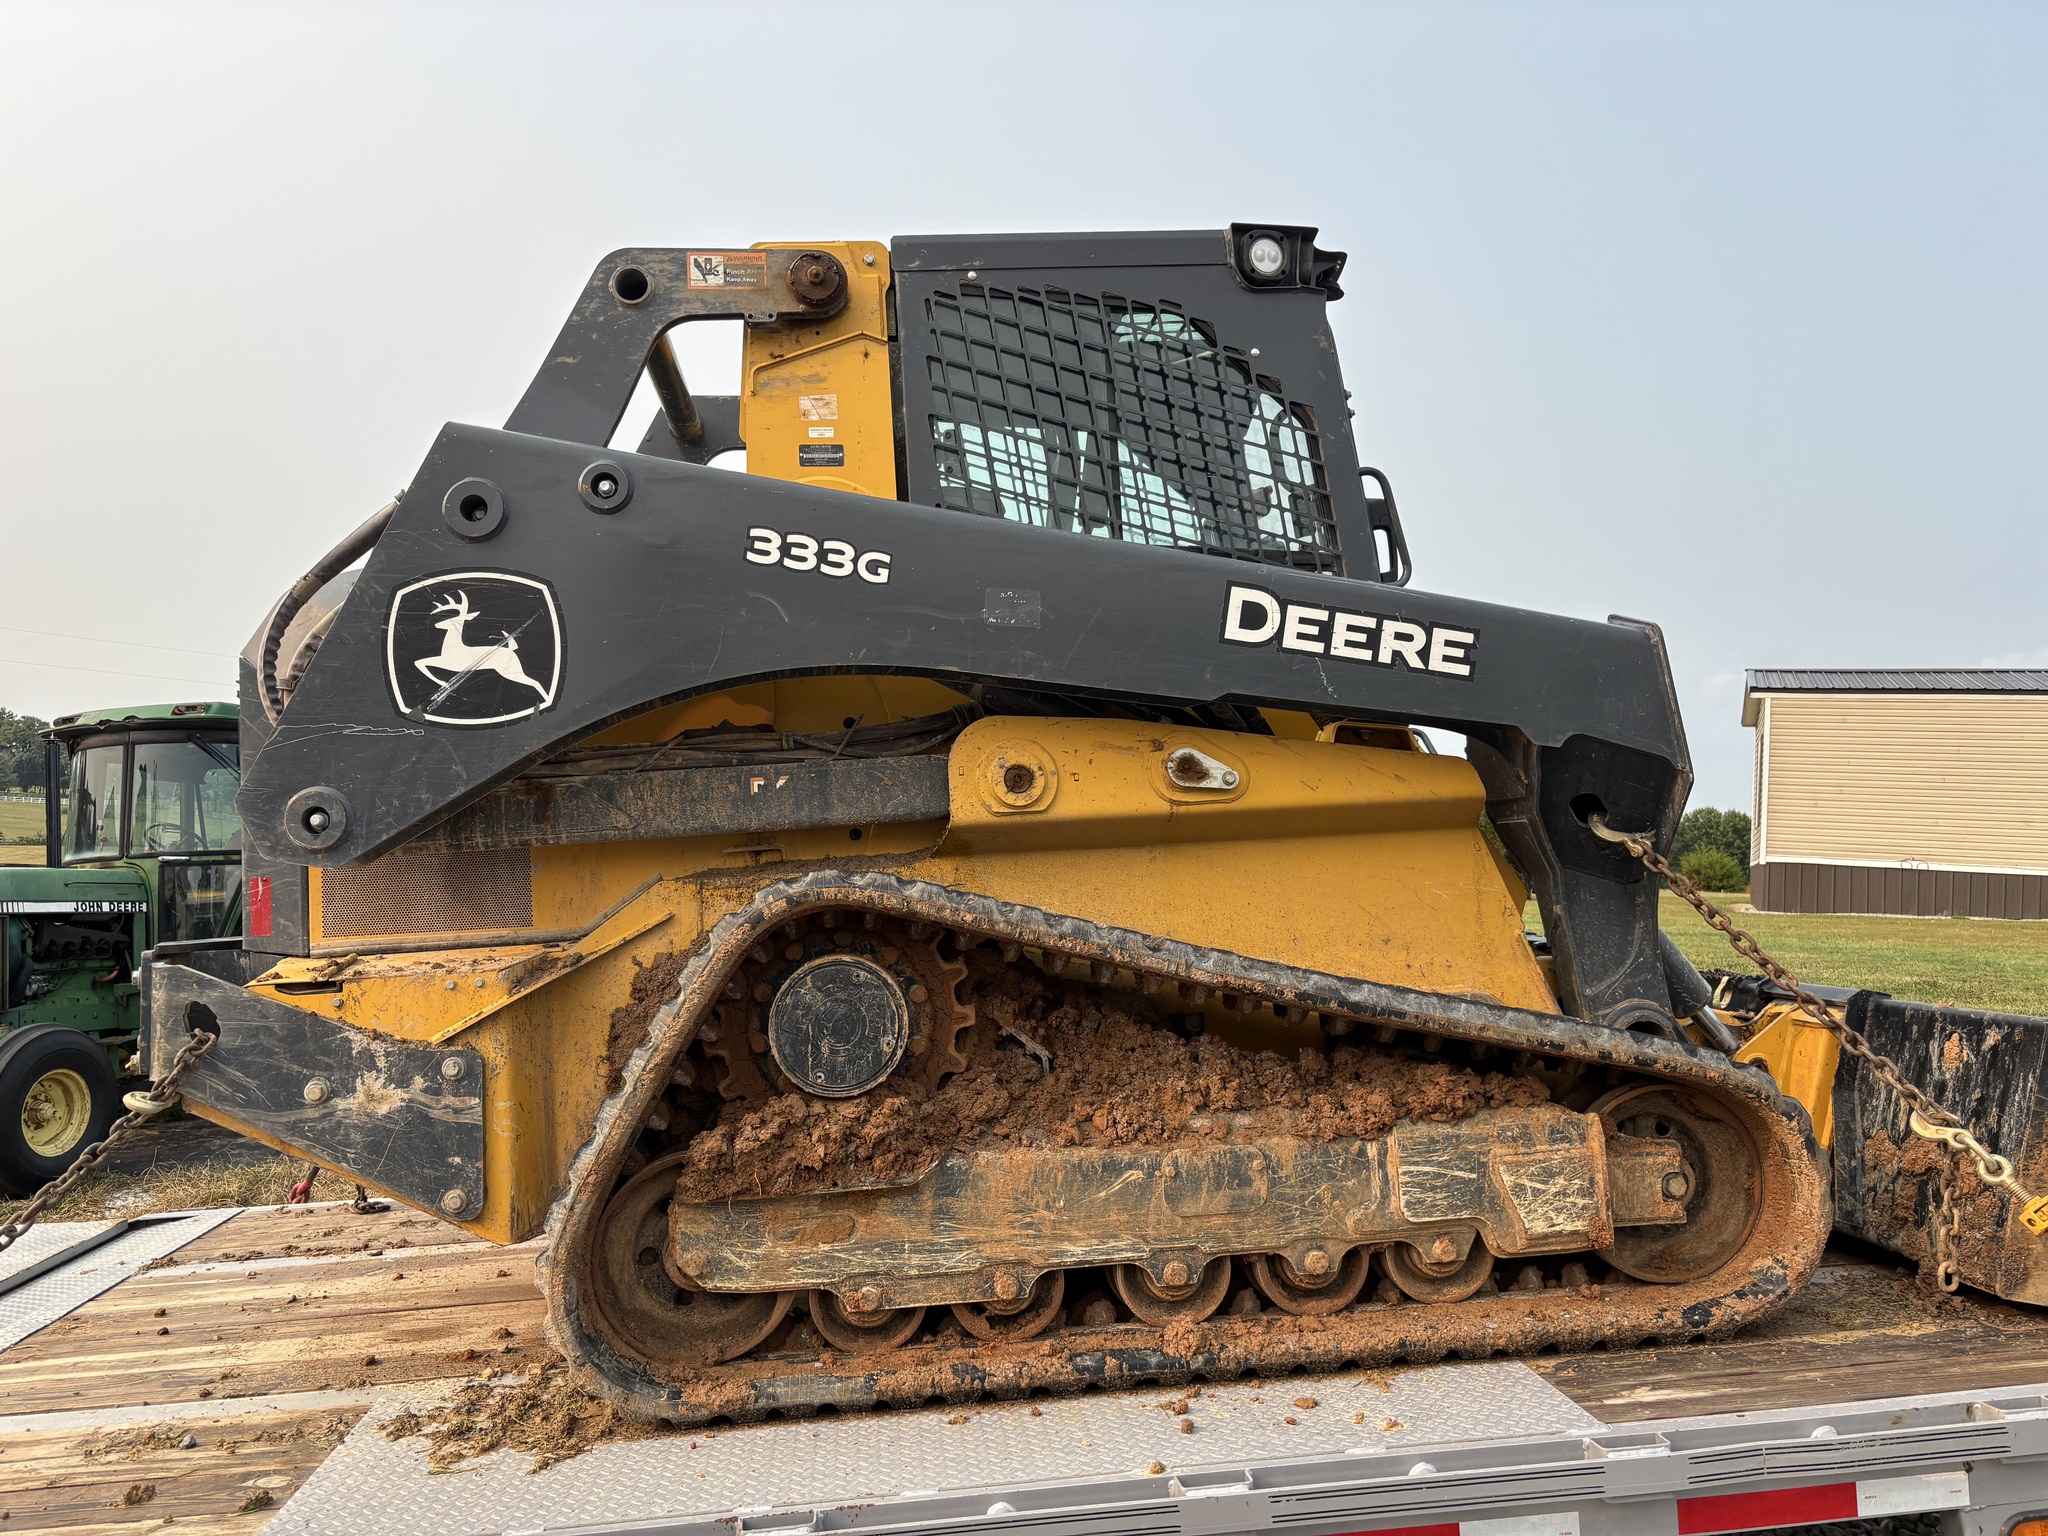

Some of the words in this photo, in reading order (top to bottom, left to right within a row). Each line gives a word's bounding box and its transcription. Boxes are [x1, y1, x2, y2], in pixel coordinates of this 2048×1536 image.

[746, 528, 891, 583] 333G
[1224, 586, 1474, 677] DEERE
[73, 902, 103, 912] JOHN
[109, 902, 144, 912] DEERE
